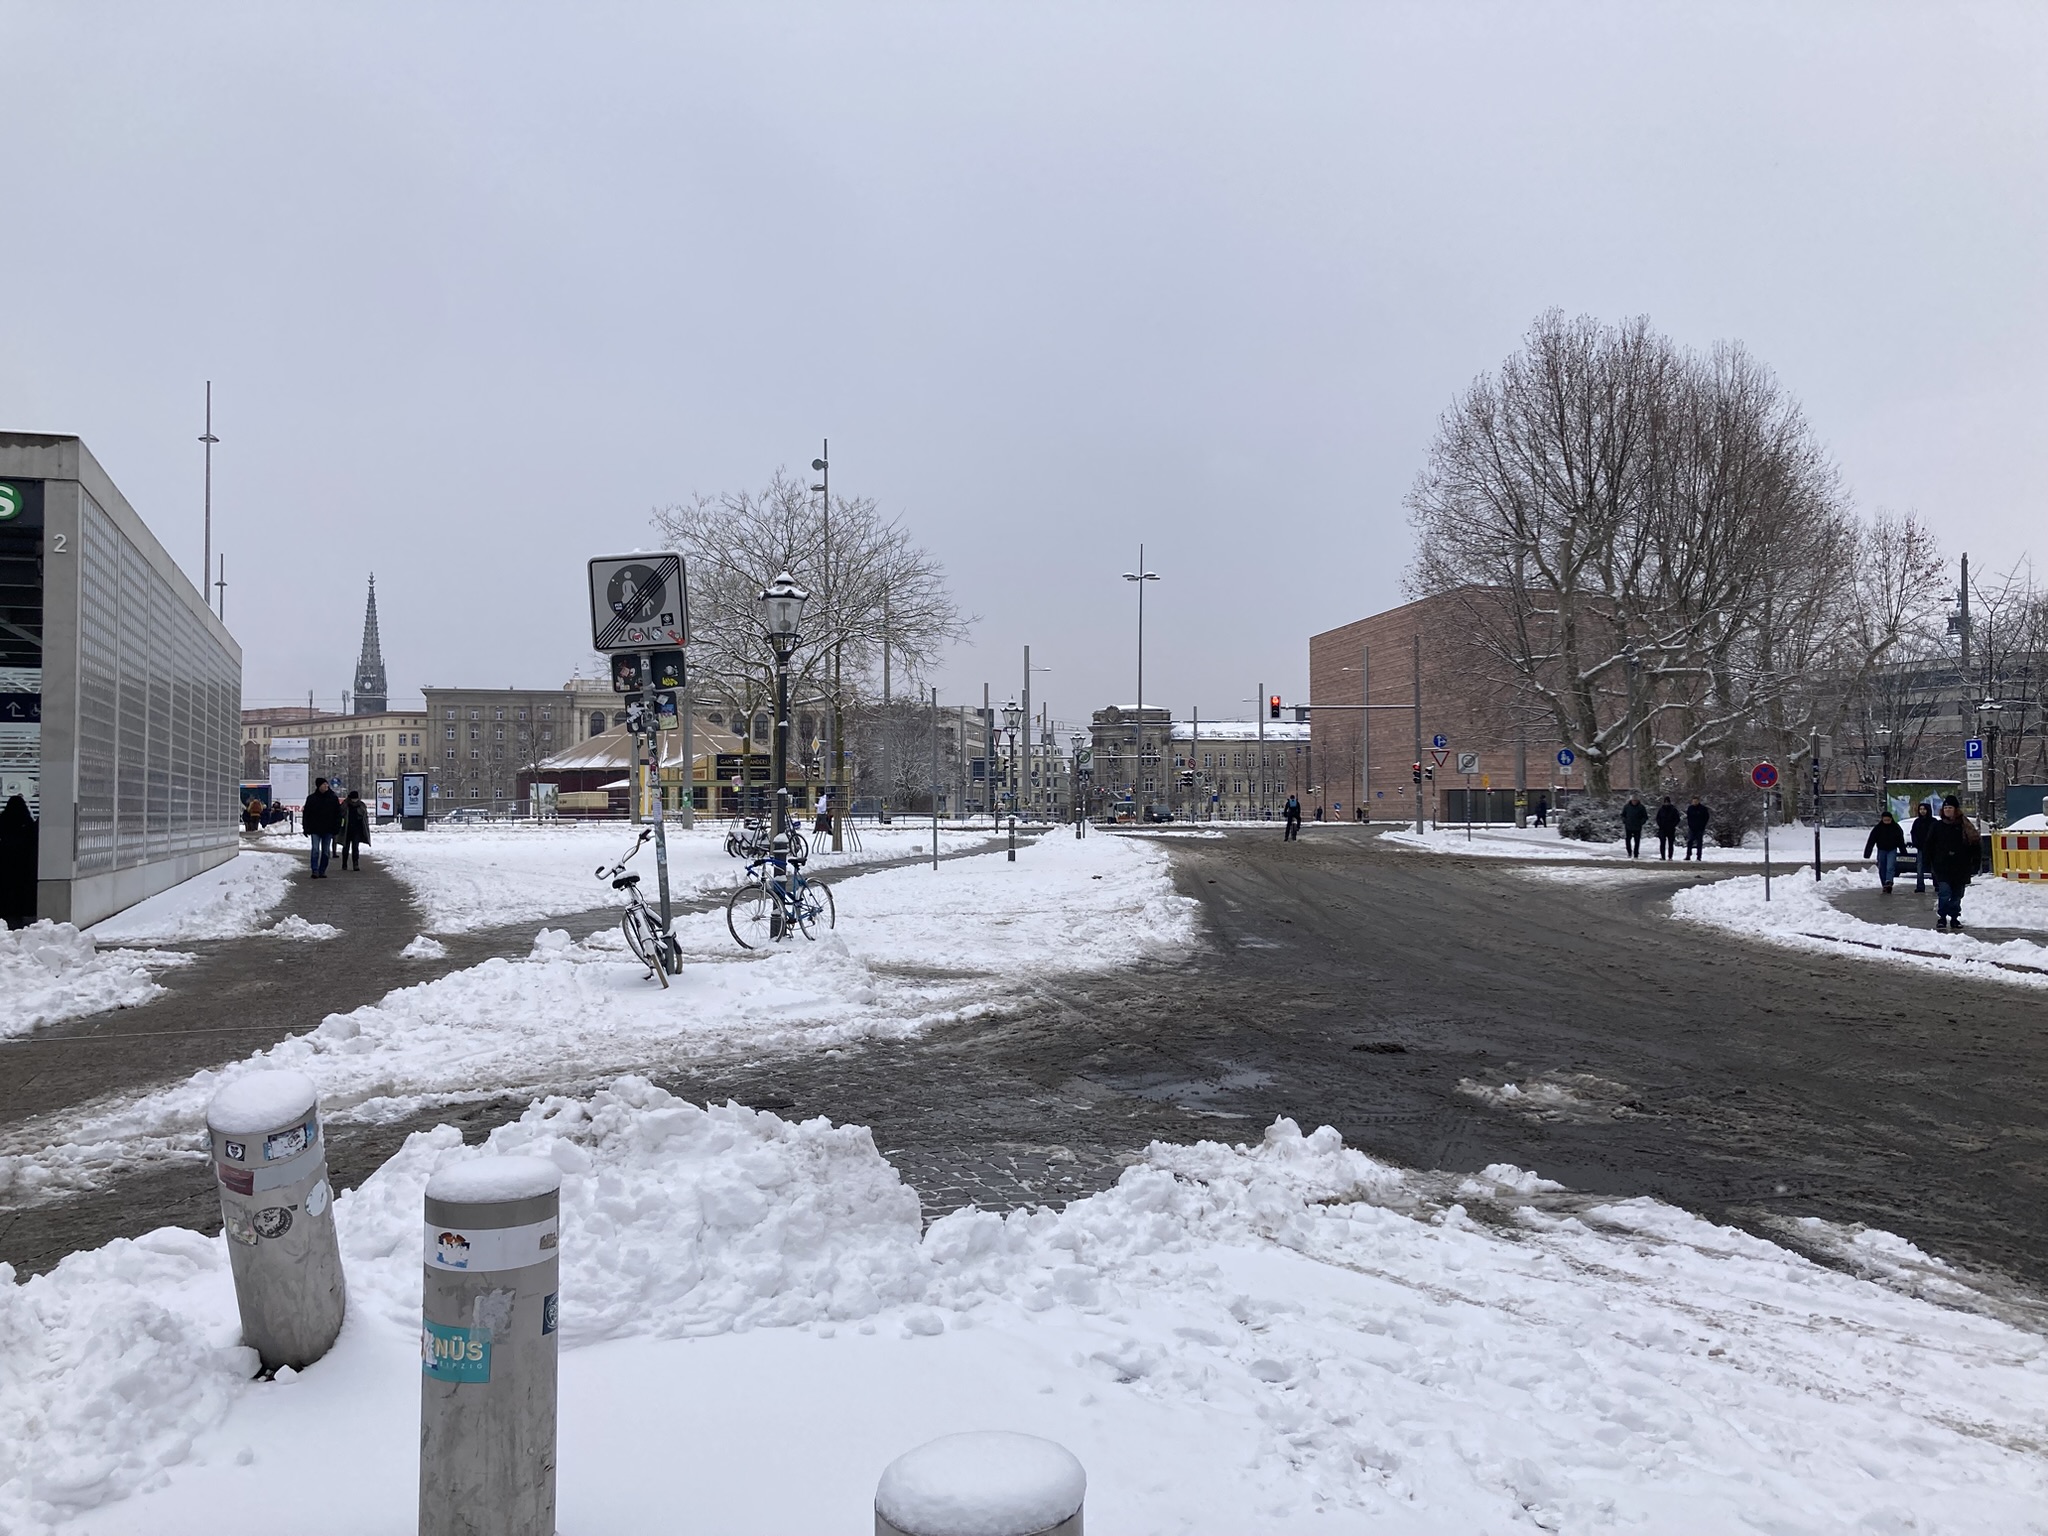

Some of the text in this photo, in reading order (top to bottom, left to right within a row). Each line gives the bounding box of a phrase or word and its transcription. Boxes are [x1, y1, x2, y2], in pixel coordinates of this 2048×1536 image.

[0, 485, 15, 517] S
[53, 533, 67, 553] 2
[1969, 742, 1979, 757] P
